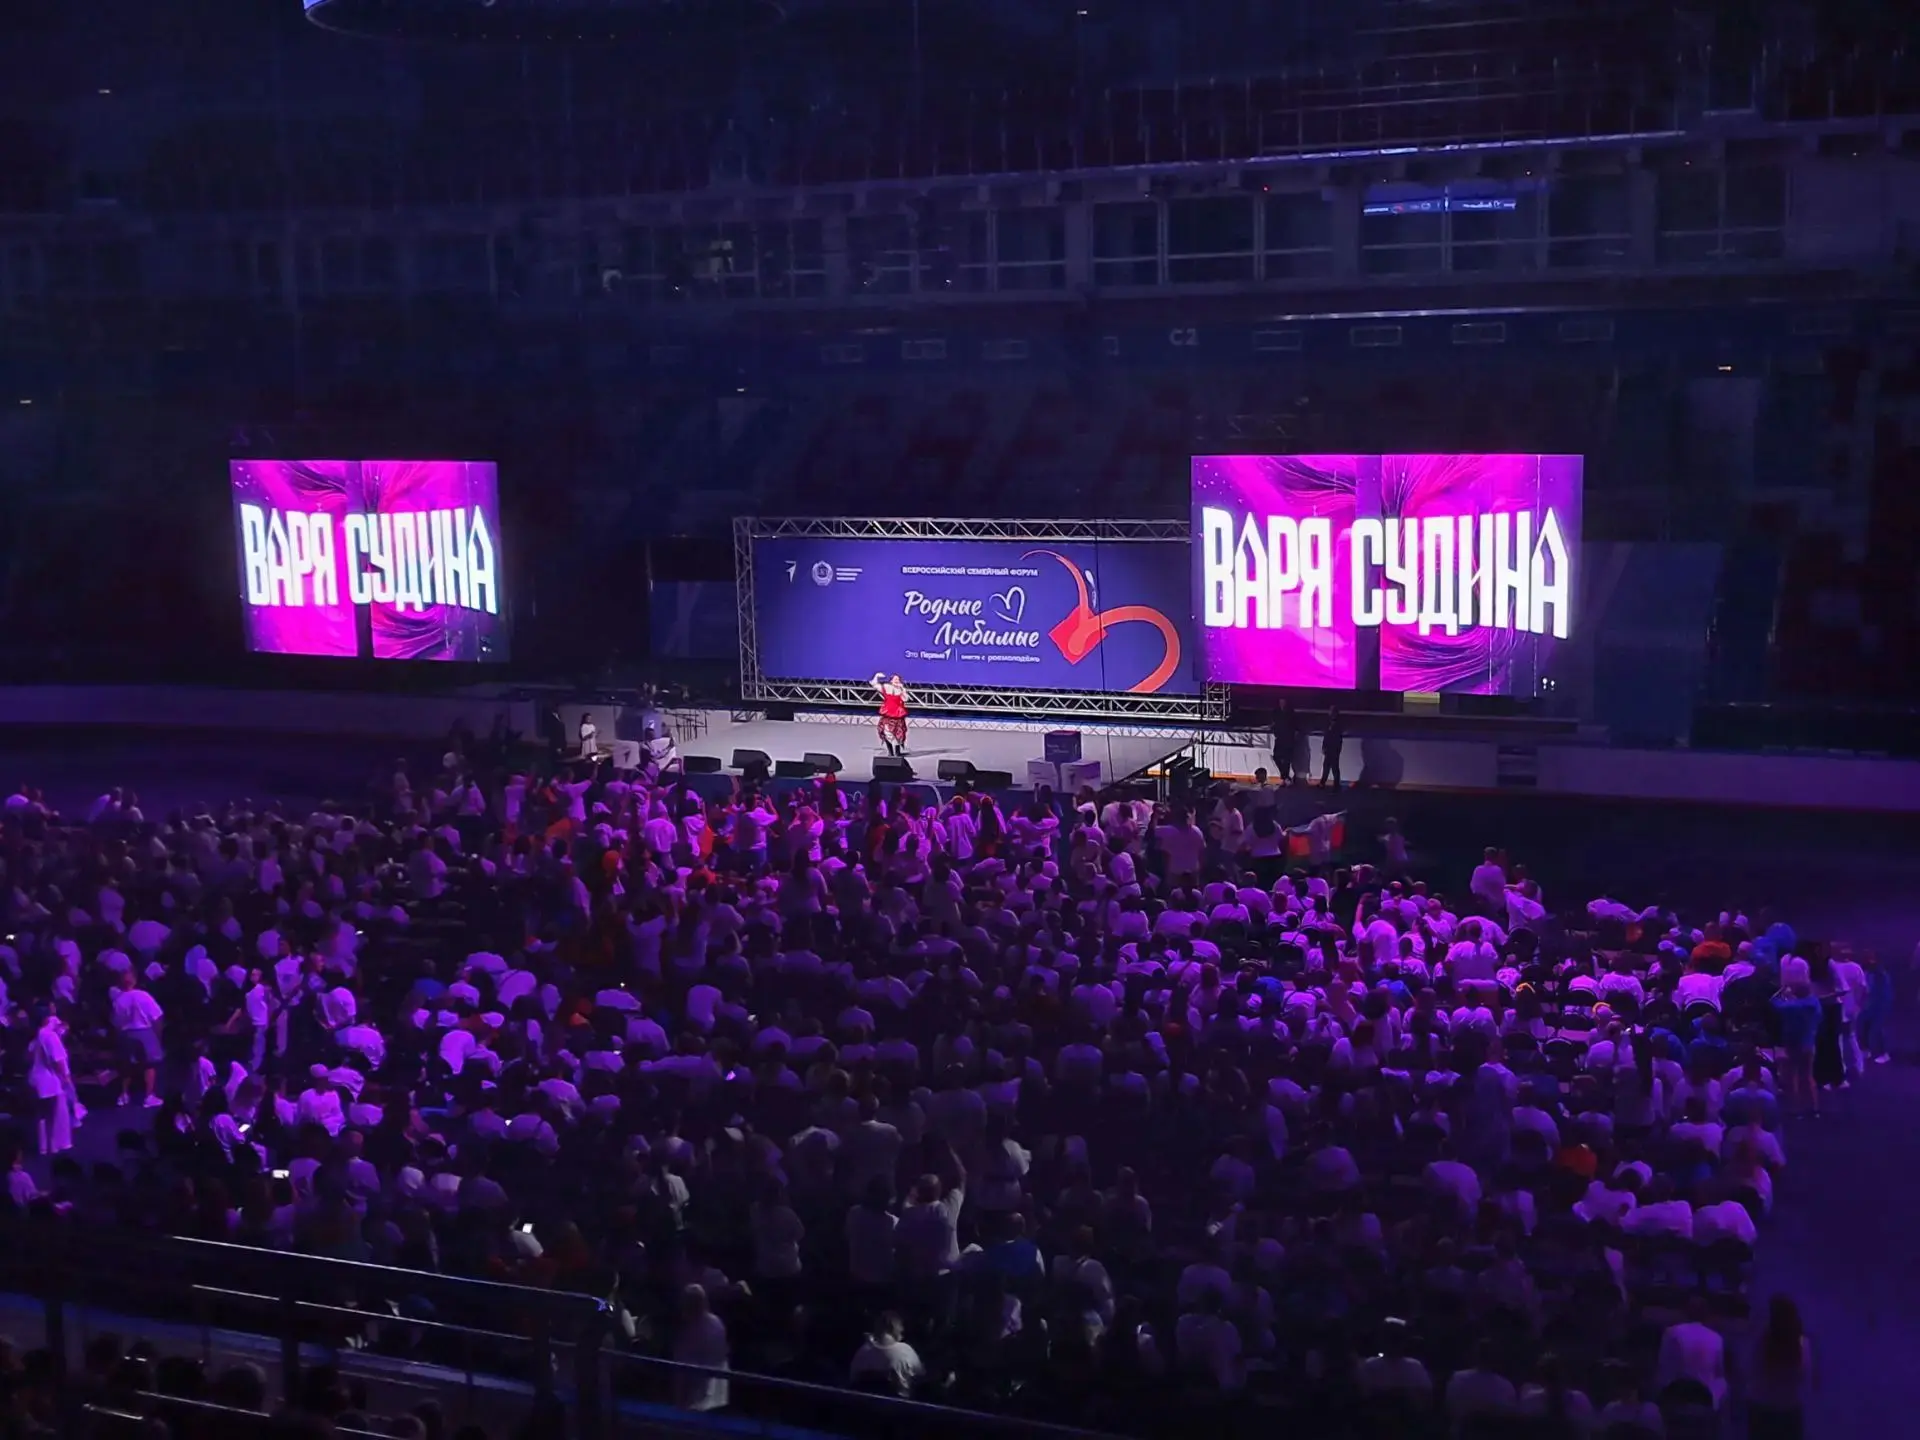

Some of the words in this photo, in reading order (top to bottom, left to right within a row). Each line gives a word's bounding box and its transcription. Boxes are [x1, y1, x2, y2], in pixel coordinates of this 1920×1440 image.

[240, 503, 338, 606] ВАРЯ
[345, 505, 498, 615] СУДИНА
[902, 566, 966, 576] ВСЕРОССИЙСКИЙ
[967, 567, 1009, 576] СЕМЕЙНЫЙ
[1010, 568, 1039, 577] ФОРУМ
[1202, 507, 1332, 629] ВАРЯ
[1350, 507, 1569, 639] СУДИНА
[904, 590, 983, 624] Родные
[934, 620, 1040, 648] Любимые
